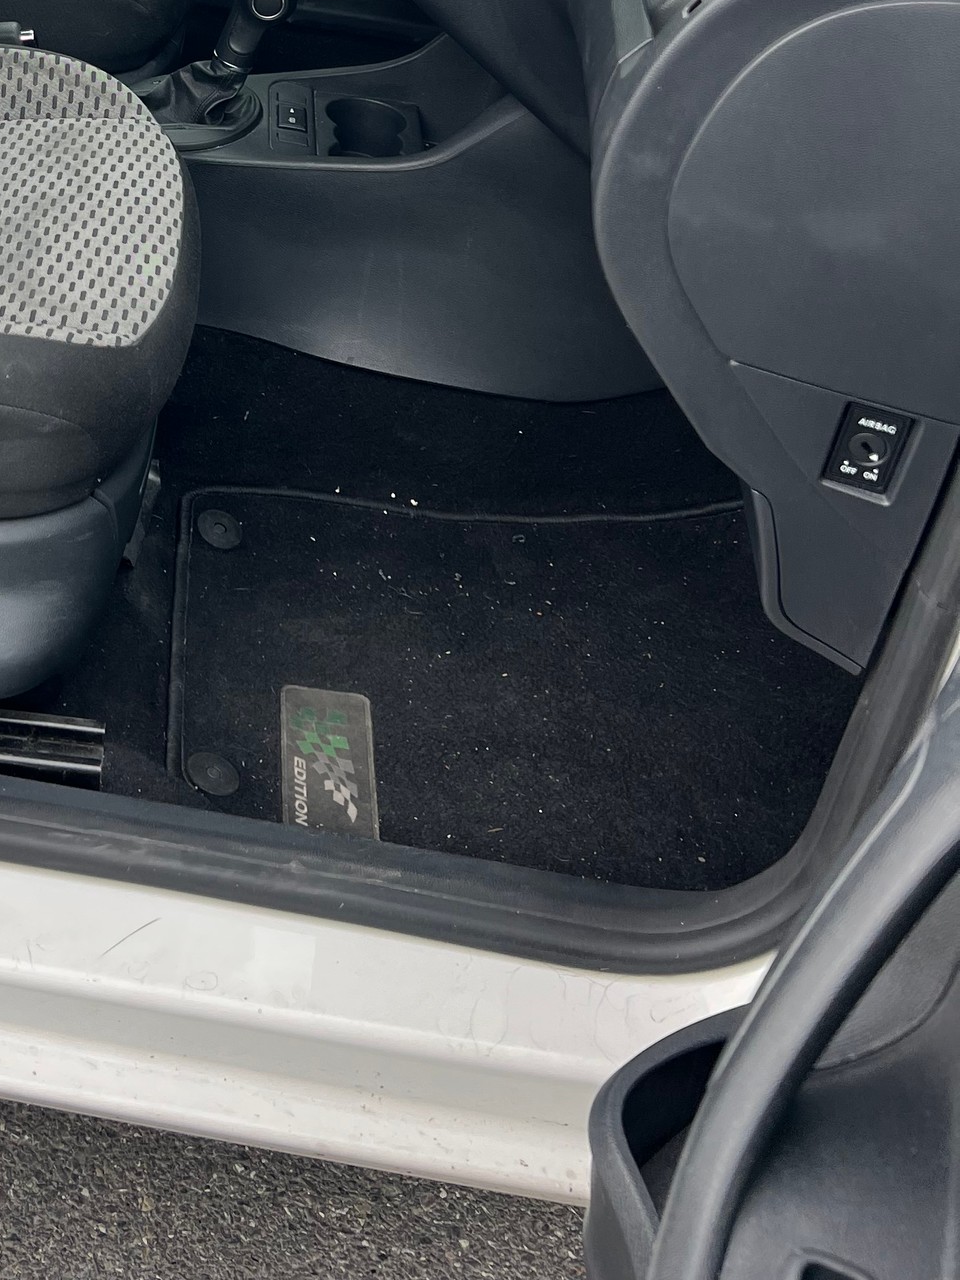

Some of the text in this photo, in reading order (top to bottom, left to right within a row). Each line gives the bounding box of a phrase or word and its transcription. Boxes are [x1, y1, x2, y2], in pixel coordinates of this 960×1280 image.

[857, 417, 897, 435] AIRBAG
[839, 464, 879, 482] OFF ON
[293, 755, 309, 827] EDITION
